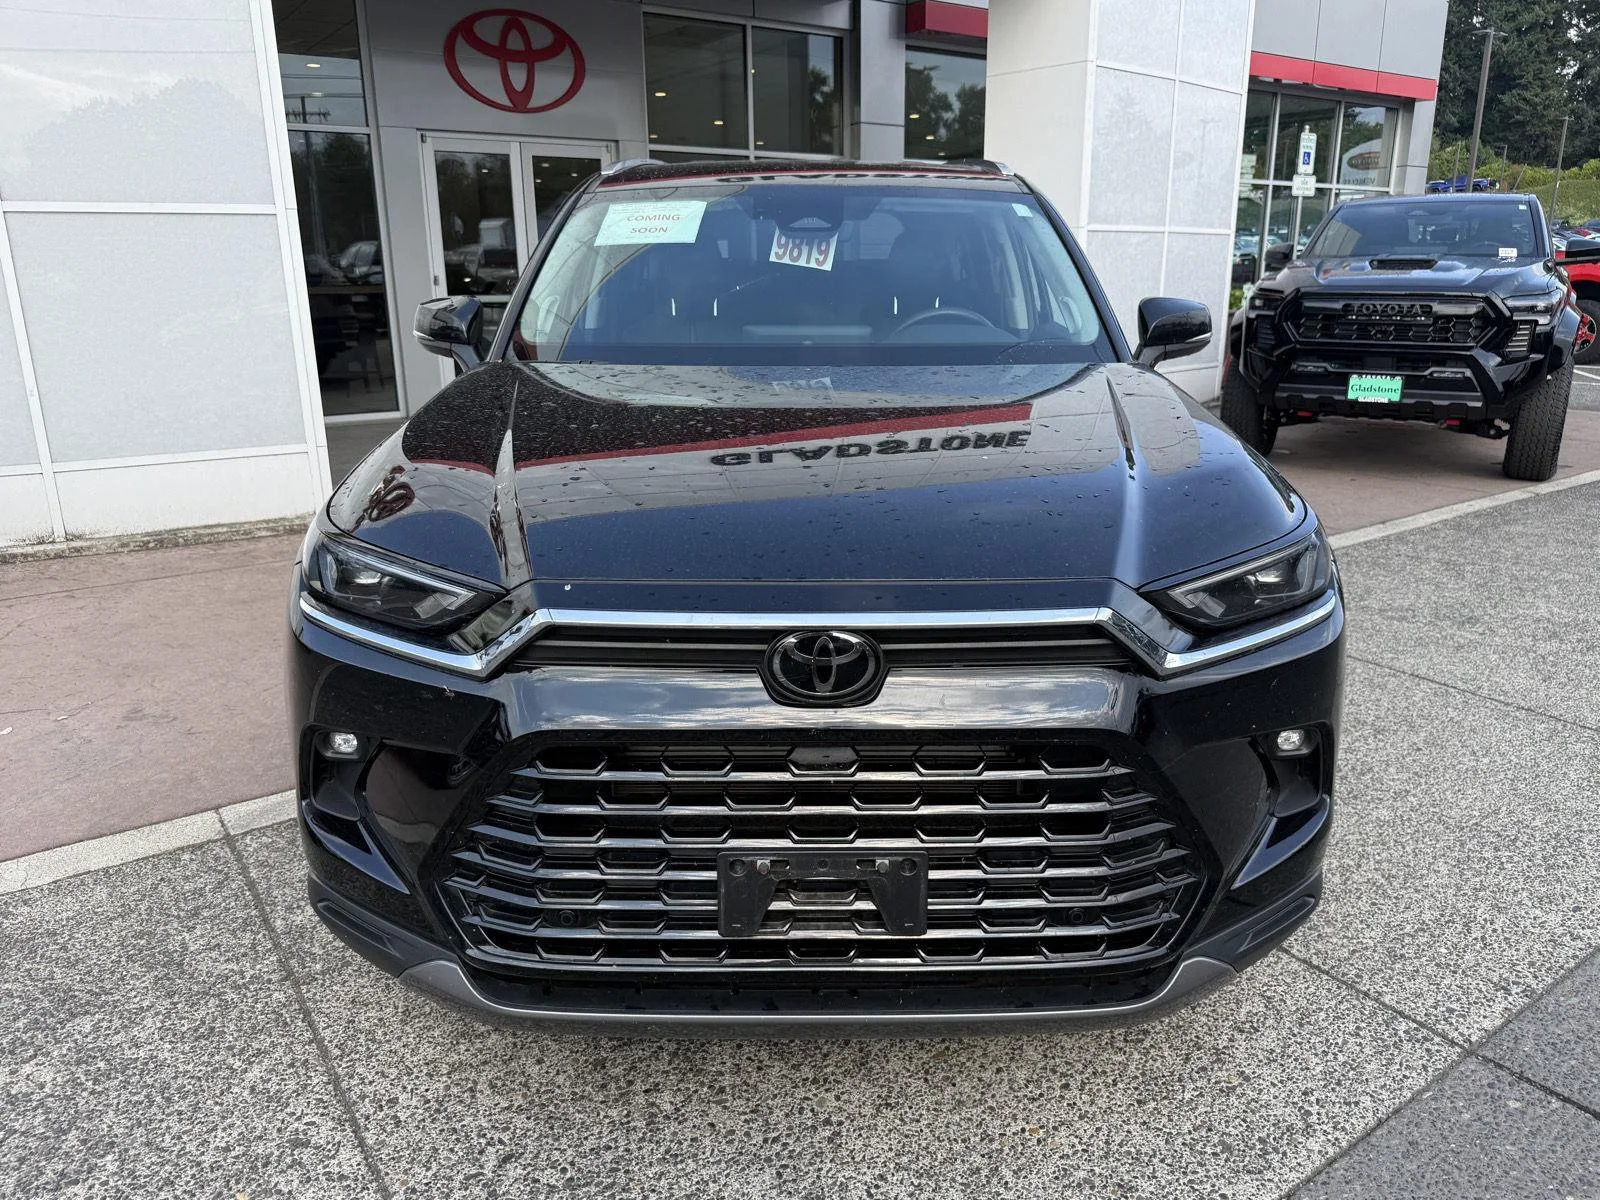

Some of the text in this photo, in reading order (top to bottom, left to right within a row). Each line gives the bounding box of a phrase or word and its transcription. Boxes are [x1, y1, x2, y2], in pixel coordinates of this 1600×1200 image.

[627, 214, 681, 222] COMING
[630, 226, 669, 234] SOON
[774, 232, 831, 267] 9819
[1350, 303, 1422, 315] TOYOTA
[1350, 384, 1400, 394] Gladstone
